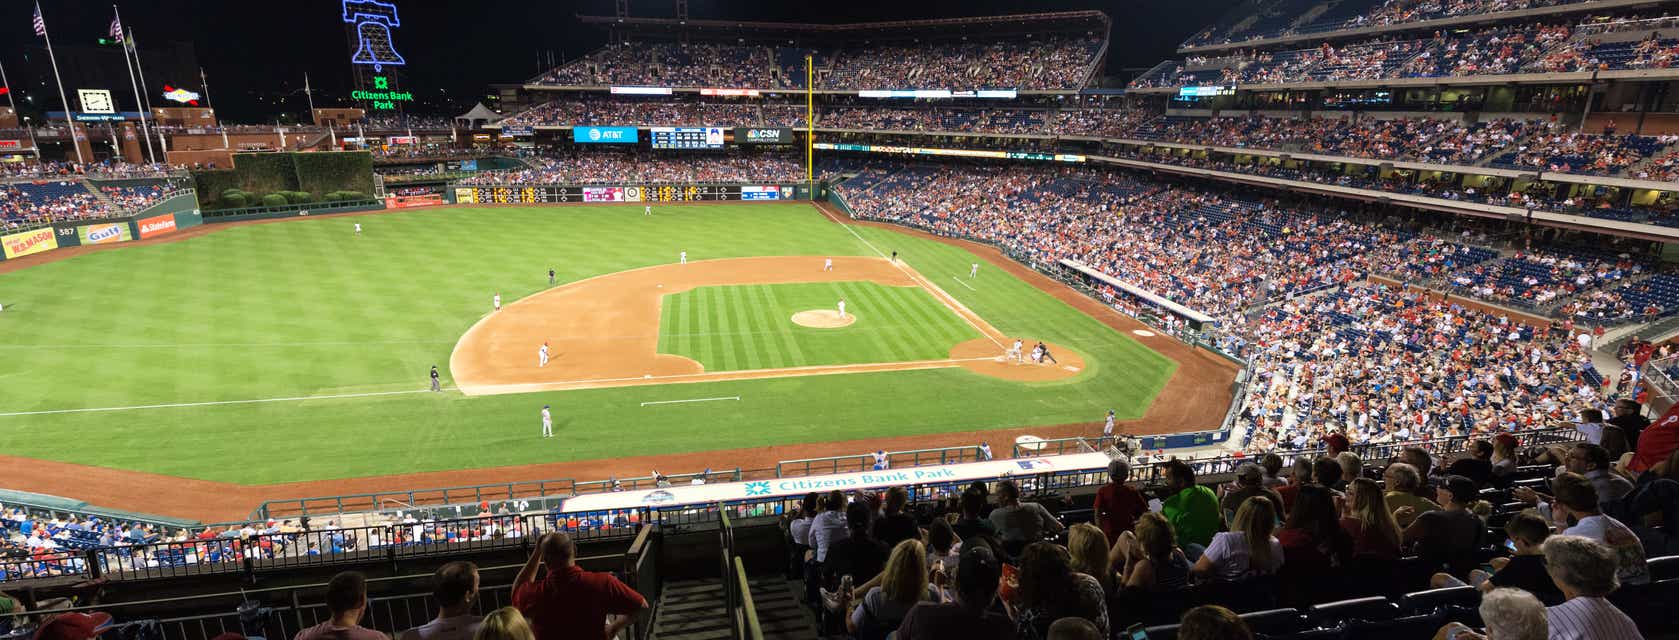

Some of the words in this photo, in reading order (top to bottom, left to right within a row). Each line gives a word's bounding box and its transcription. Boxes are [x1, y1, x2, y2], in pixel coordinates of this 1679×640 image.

[352, 90, 389, 100] Citizens
[390, 92, 413, 100] Bank
[374, 101, 394, 109] Park
[59, 228, 74, 236] 387
[89, 226, 119, 240] Gulf
[780, 478, 856, 490] Citizens
[862, 472, 909, 484] Bank
[915, 468, 956, 478] Park
